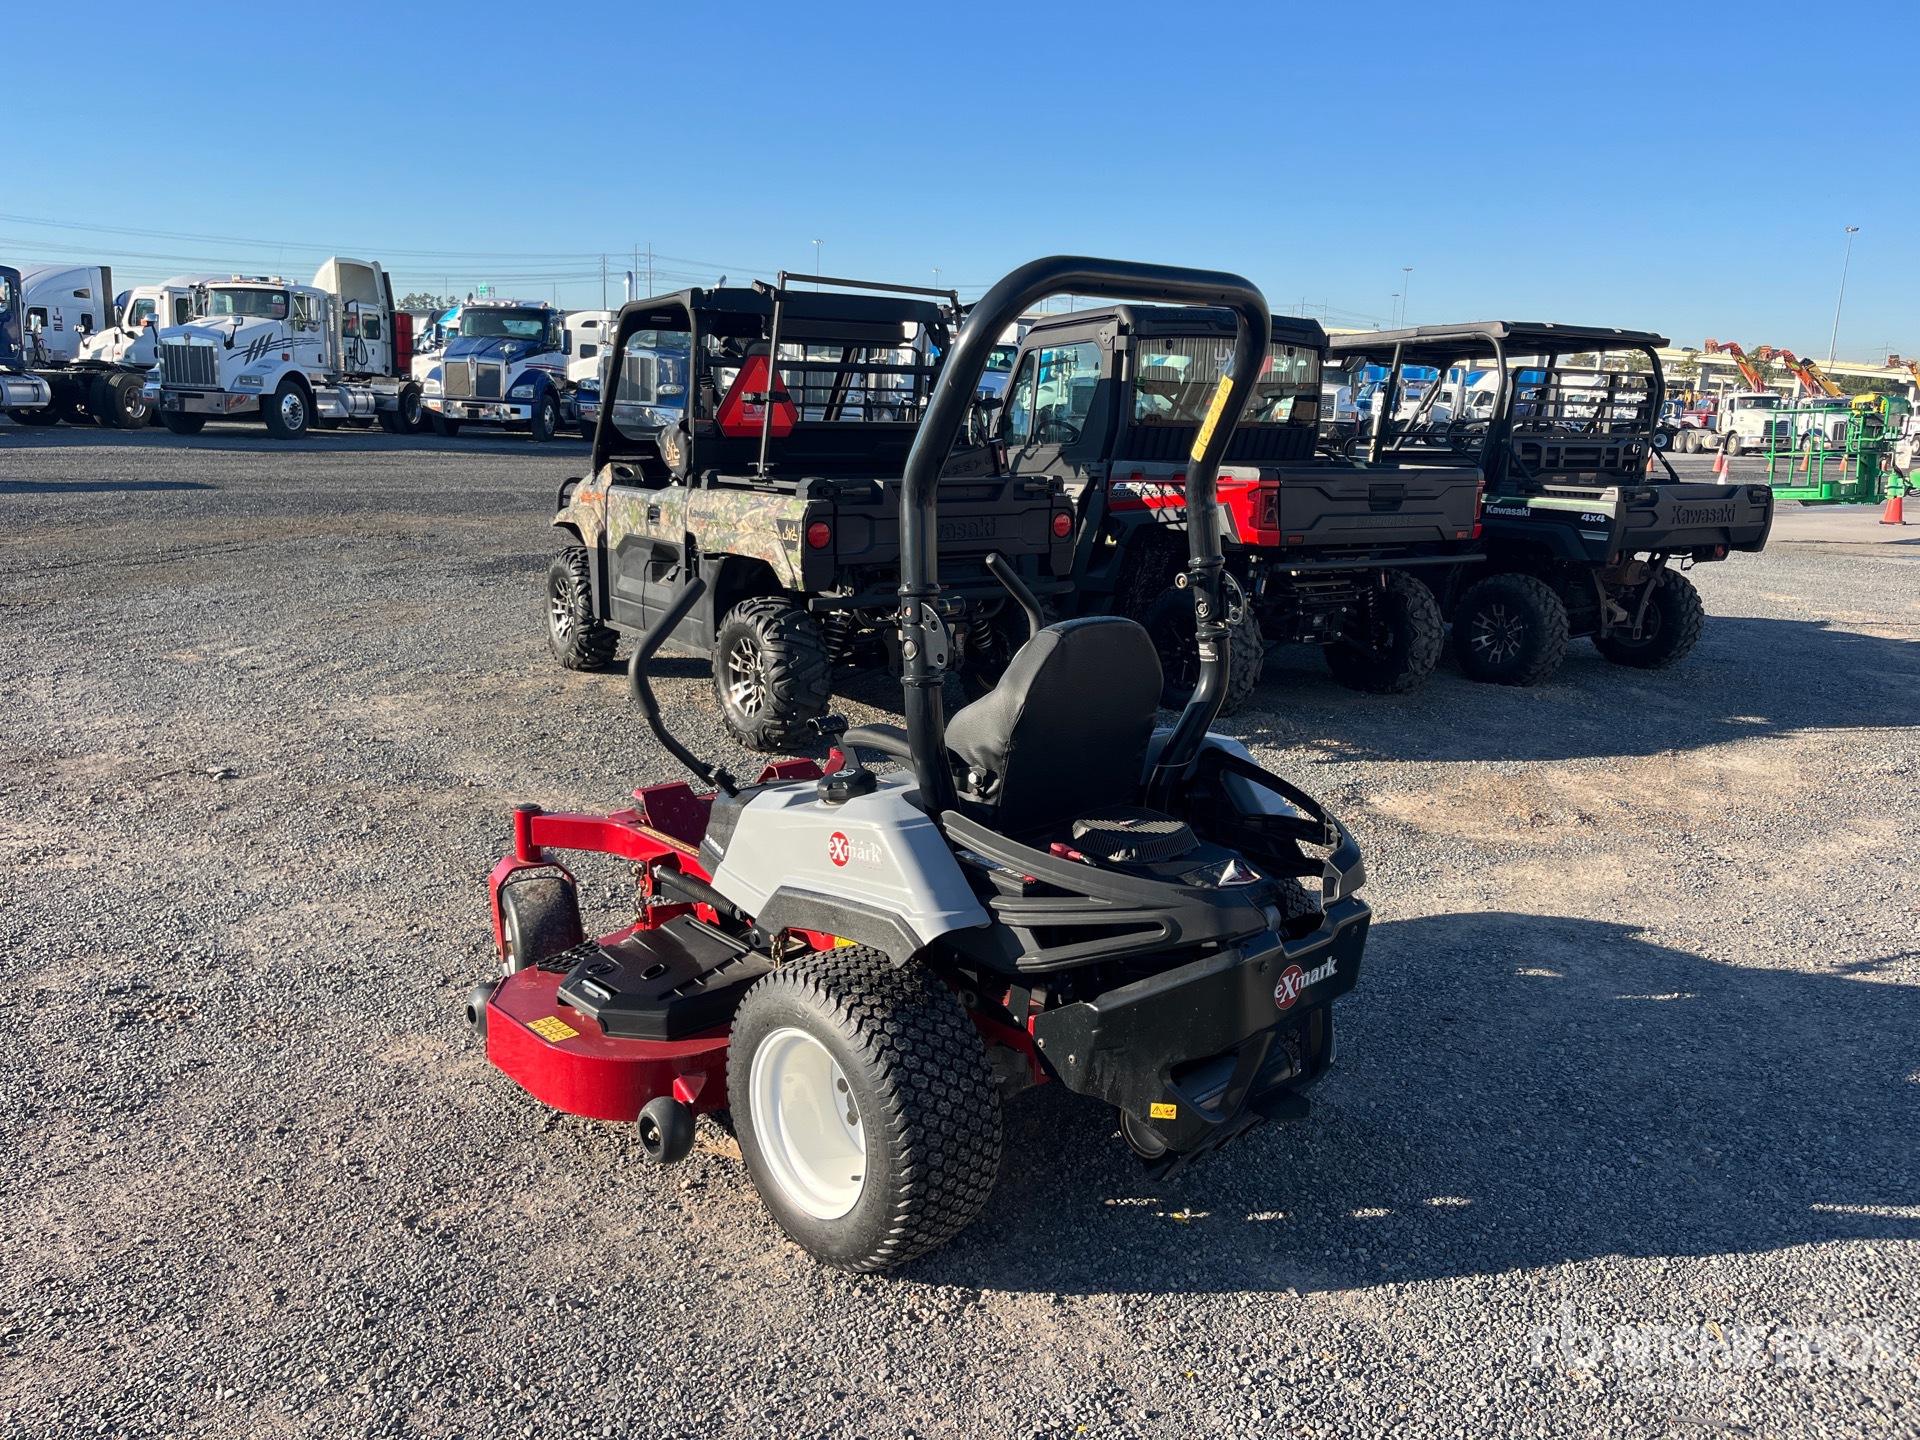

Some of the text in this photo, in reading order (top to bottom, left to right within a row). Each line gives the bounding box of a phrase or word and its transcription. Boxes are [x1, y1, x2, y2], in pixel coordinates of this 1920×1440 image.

[1486, 505, 1531, 517] Kawasaki
[1581, 513, 1606, 522] 4x4
[1671, 503, 1736, 524] Kawasaki
[1274, 956, 1338, 1004] eXmark
